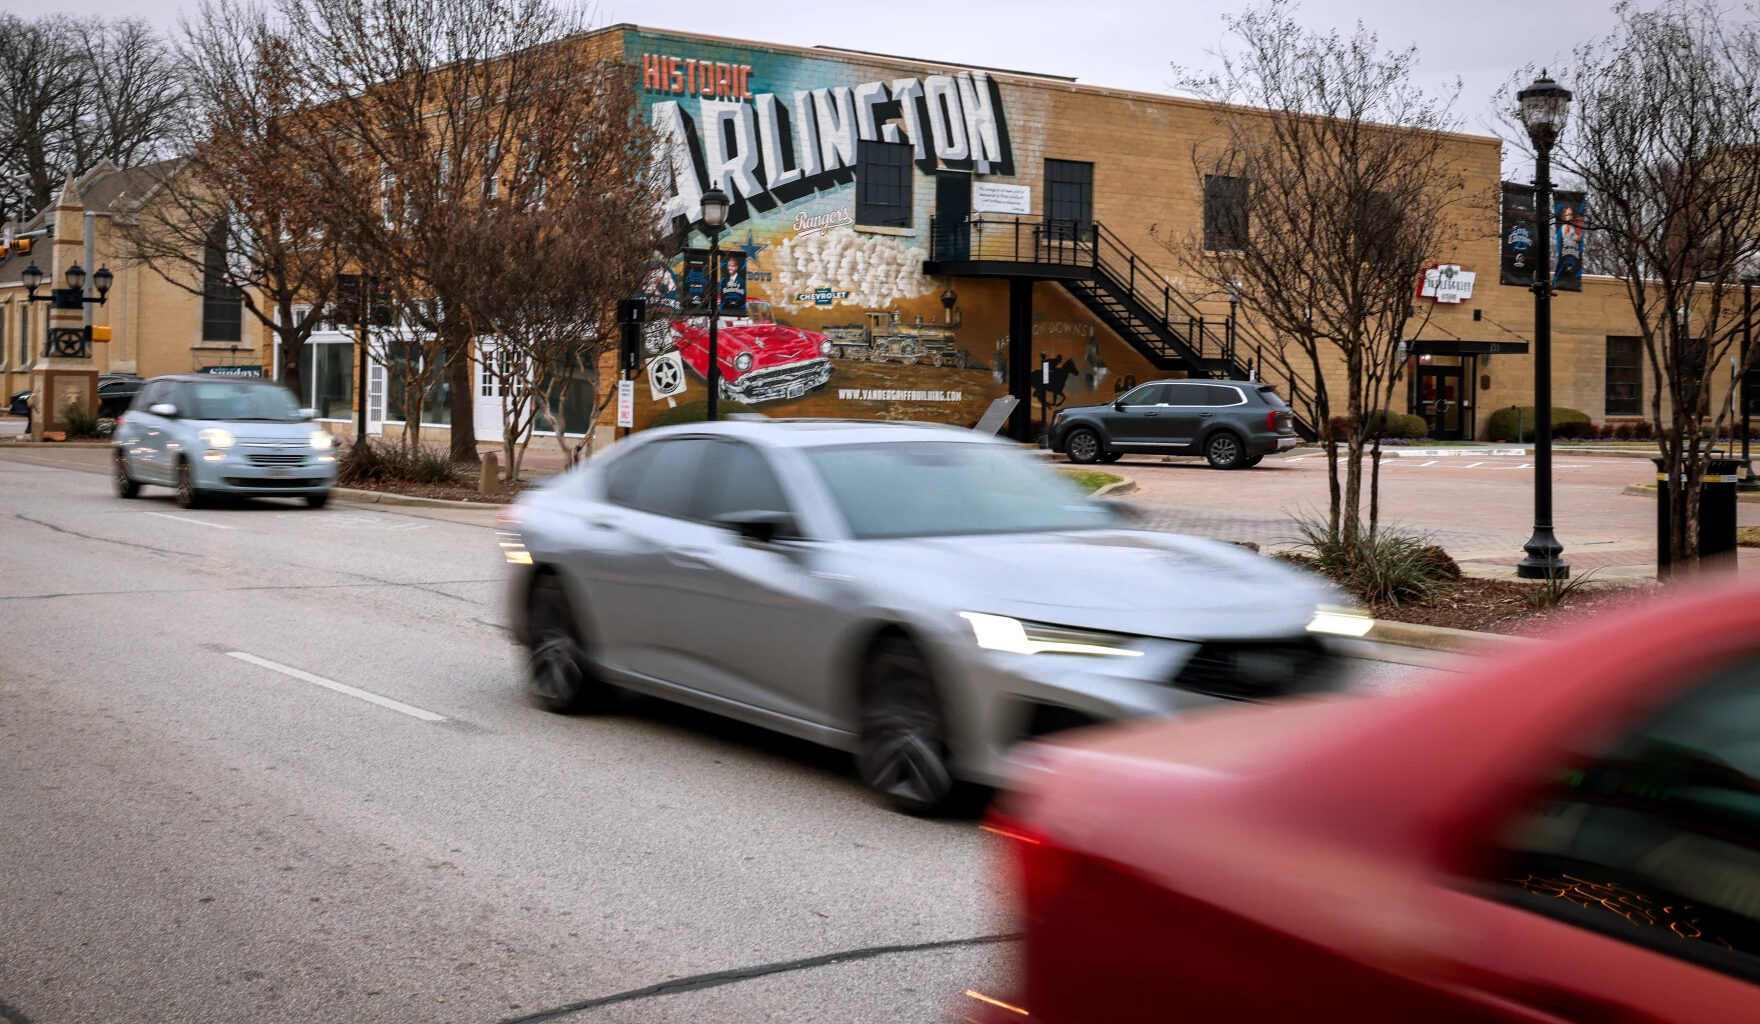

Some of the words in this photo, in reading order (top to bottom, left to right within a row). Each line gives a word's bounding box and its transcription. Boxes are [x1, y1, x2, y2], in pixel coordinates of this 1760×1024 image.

[643, 53, 753, 101] HISTORIC
[650, 70, 1004, 237] ARLINGTON
[793, 207, 853, 237] Rangers
[799, 291, 847, 301] CHEVROLET
[1049, 321, 1088, 337] DOWNS
